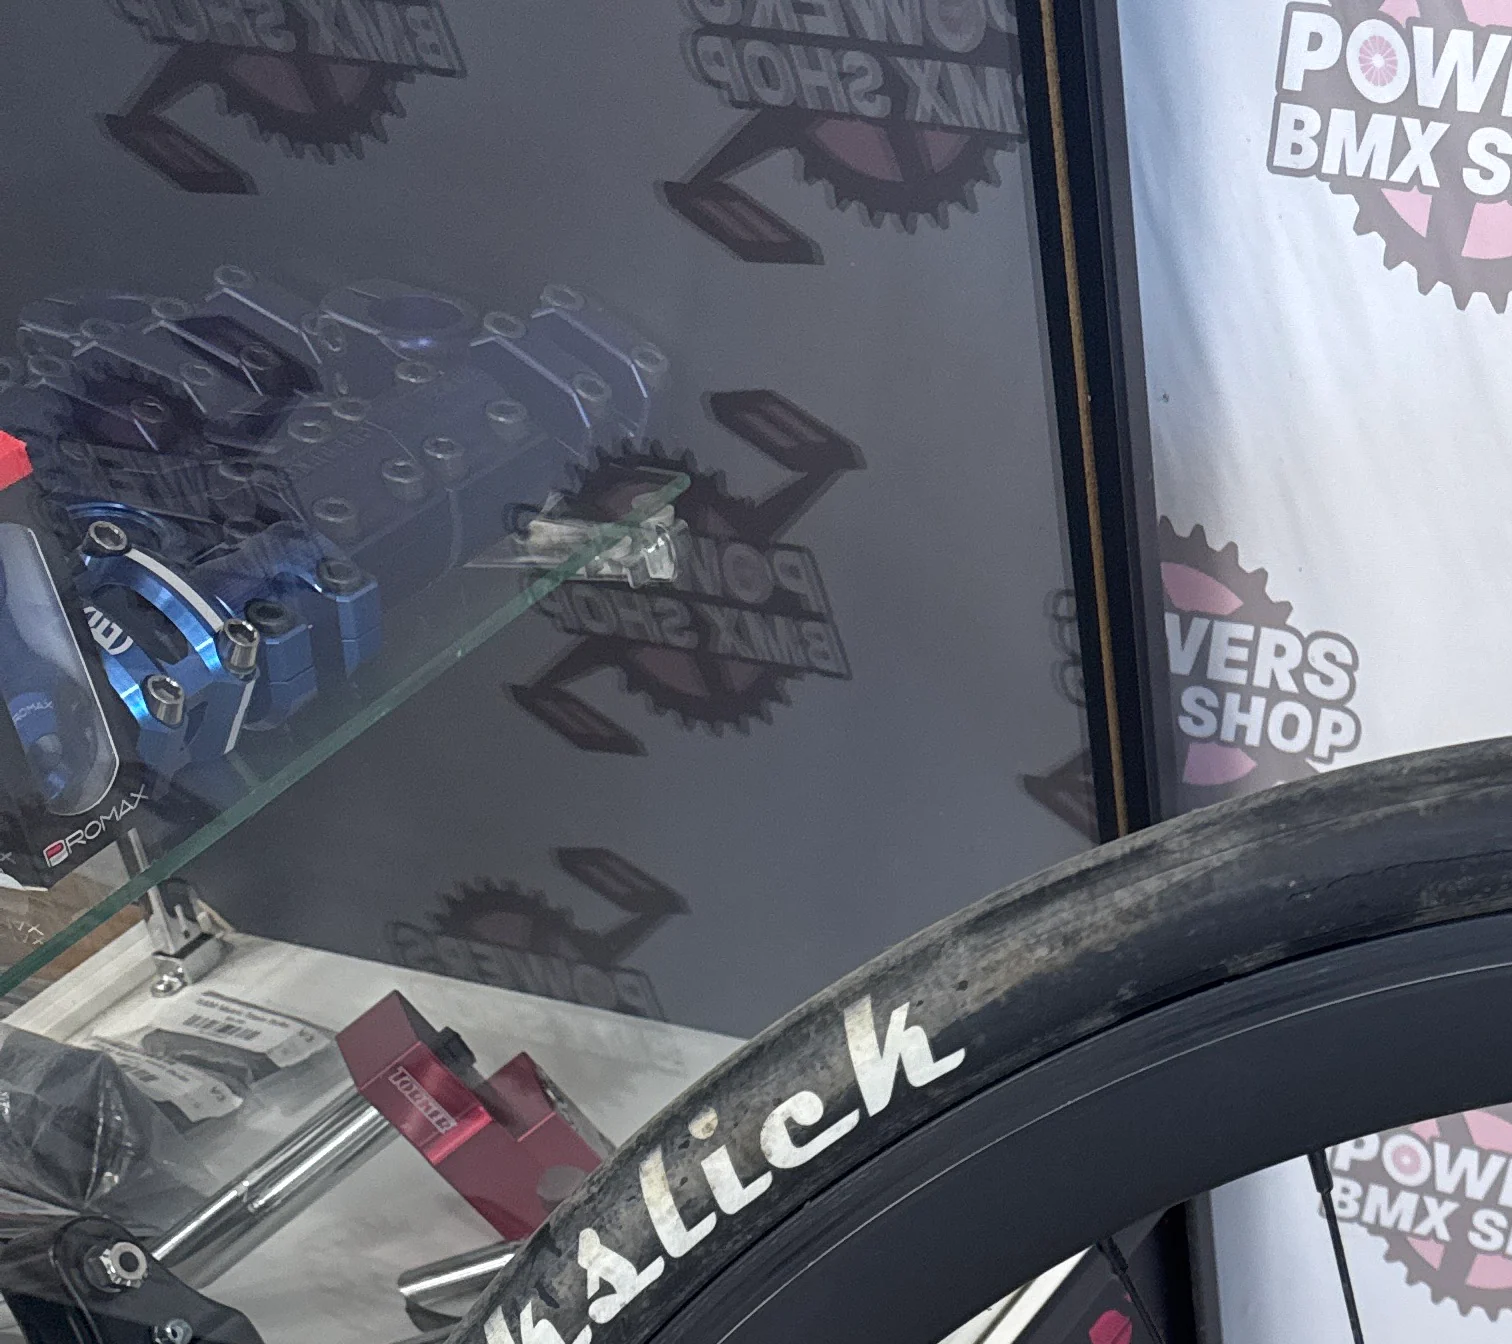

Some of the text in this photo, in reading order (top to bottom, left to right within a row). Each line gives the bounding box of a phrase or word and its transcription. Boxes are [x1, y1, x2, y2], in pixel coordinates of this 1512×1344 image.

[1273, 103, 1450, 189] BMX
[1178, 685, 1356, 758] SHOP
[43, 784, 149, 867] PROMAX
[1331, 1176, 1461, 1242] BMX
